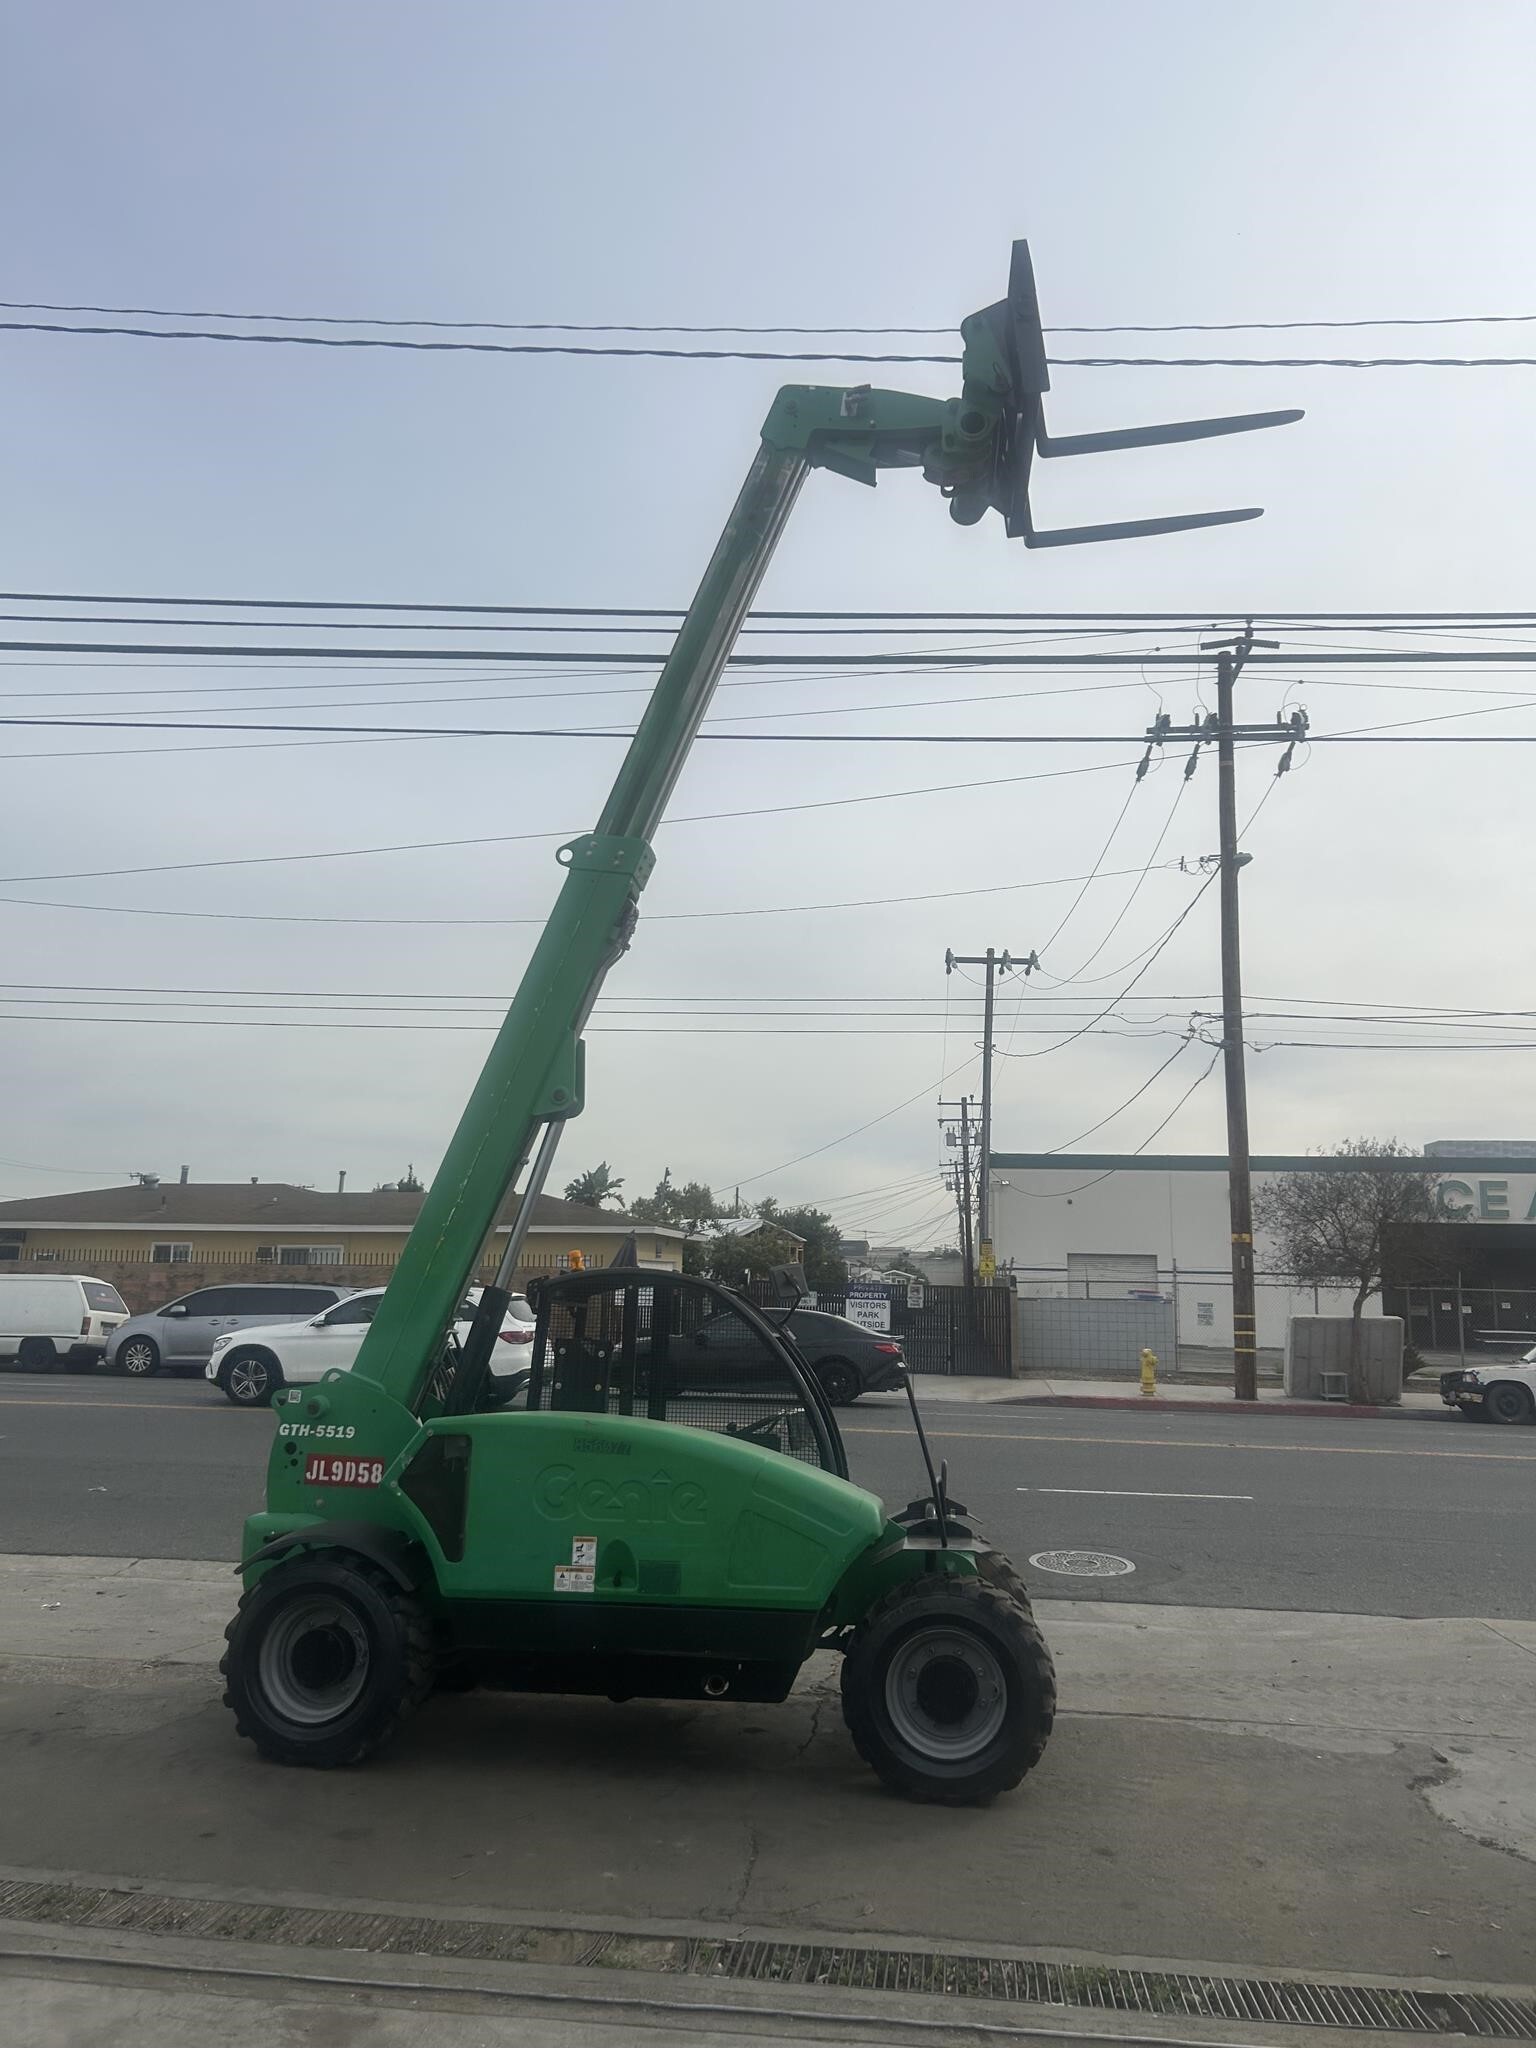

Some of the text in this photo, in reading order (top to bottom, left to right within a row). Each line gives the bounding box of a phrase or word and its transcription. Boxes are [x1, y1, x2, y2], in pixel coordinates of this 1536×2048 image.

[849, 1291, 888, 1299] PROPERTY
[850, 1301, 887, 1310] VISITORS
[857, 1311, 880, 1319] PARK
[279, 1423, 356, 1439] GTH-5519
[532, 1463, 708, 1524] Genie
